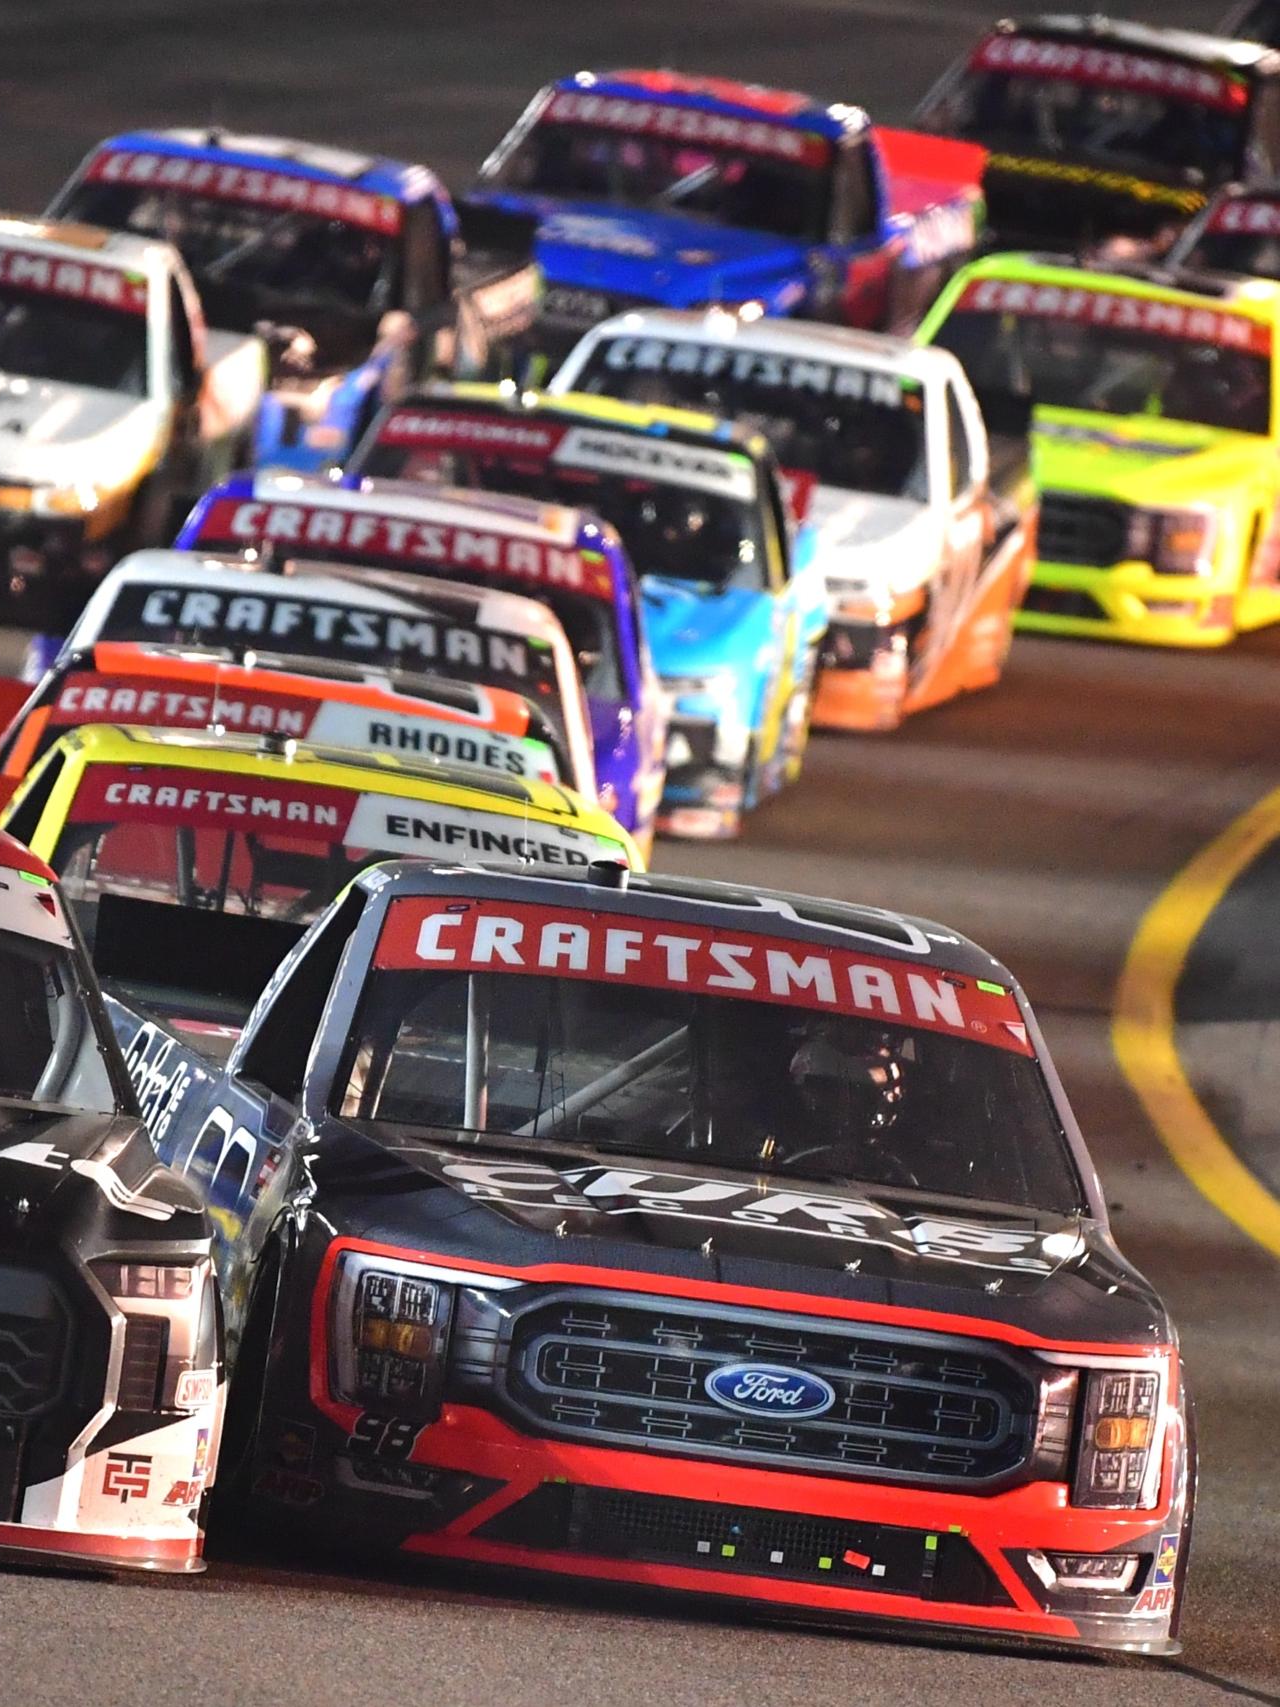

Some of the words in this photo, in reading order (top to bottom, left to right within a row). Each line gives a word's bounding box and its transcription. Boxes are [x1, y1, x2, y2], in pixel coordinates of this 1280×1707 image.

[103, 151, 380, 225] CRAFTSMAN
[605, 338, 902, 408] CRAFTSMAN
[231, 502, 583, 587] CRAFTSMAN
[141, 590, 527, 677] CRAFTSMAN
[59, 686, 307, 734] CRAFTSMAN
[369, 721, 526, 776] RHODES
[104, 782, 338, 827] CRAFTSMAN
[415, 913, 964, 1028] CRAFTSMAN
[441, 1163, 1036, 1254] CURB
[733, 1371, 807, 1406] Ford
[345, 1410, 432, 1461] 98
